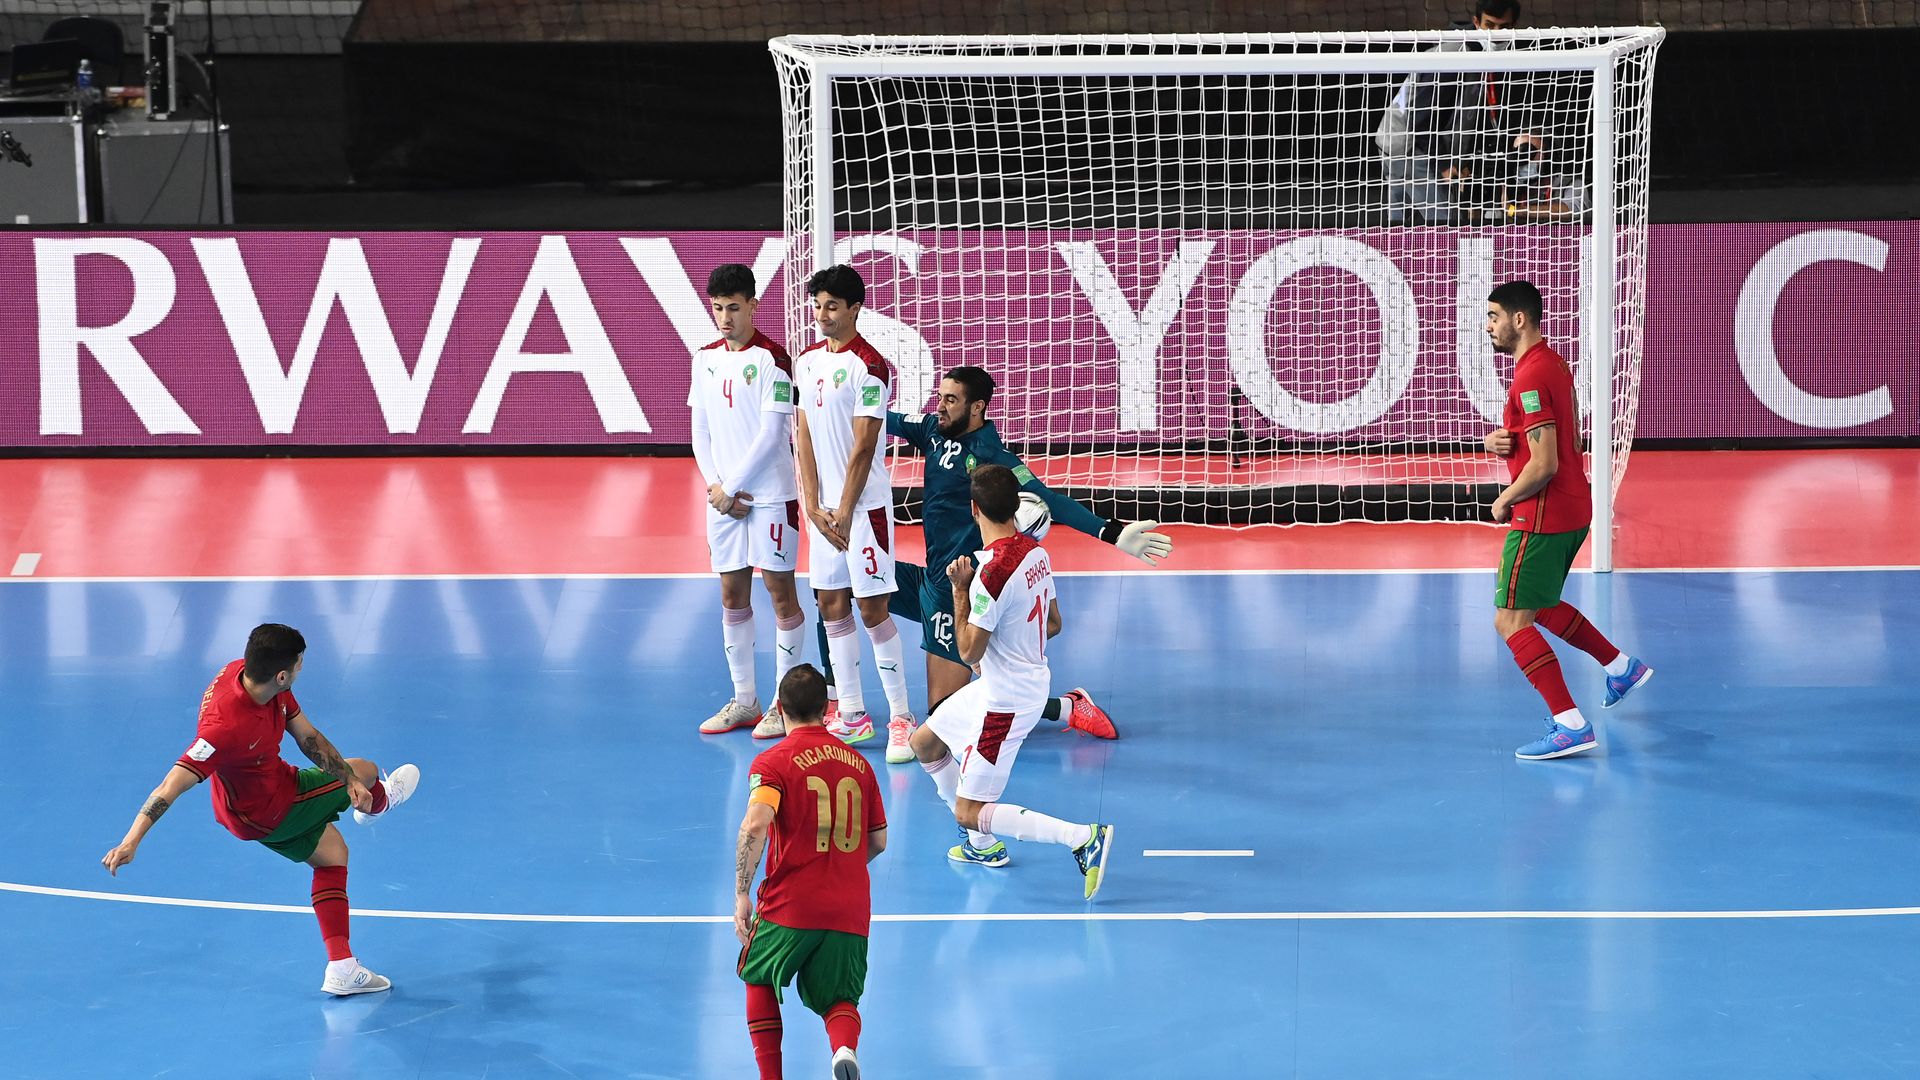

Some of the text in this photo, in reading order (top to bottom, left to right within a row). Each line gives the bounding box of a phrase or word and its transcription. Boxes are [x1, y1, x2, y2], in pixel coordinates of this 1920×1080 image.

[1734, 228, 1893, 430] C
[722, 378, 733, 409] 4
[816, 378, 825, 408] 3
[938, 439, 962, 470] 12
[769, 522, 783, 551] 4
[861, 546, 879, 576] 3
[930, 611, 954, 641] 12
[792, 744, 866, 775] RICARDINHO
[806, 775, 862, 854] 10
